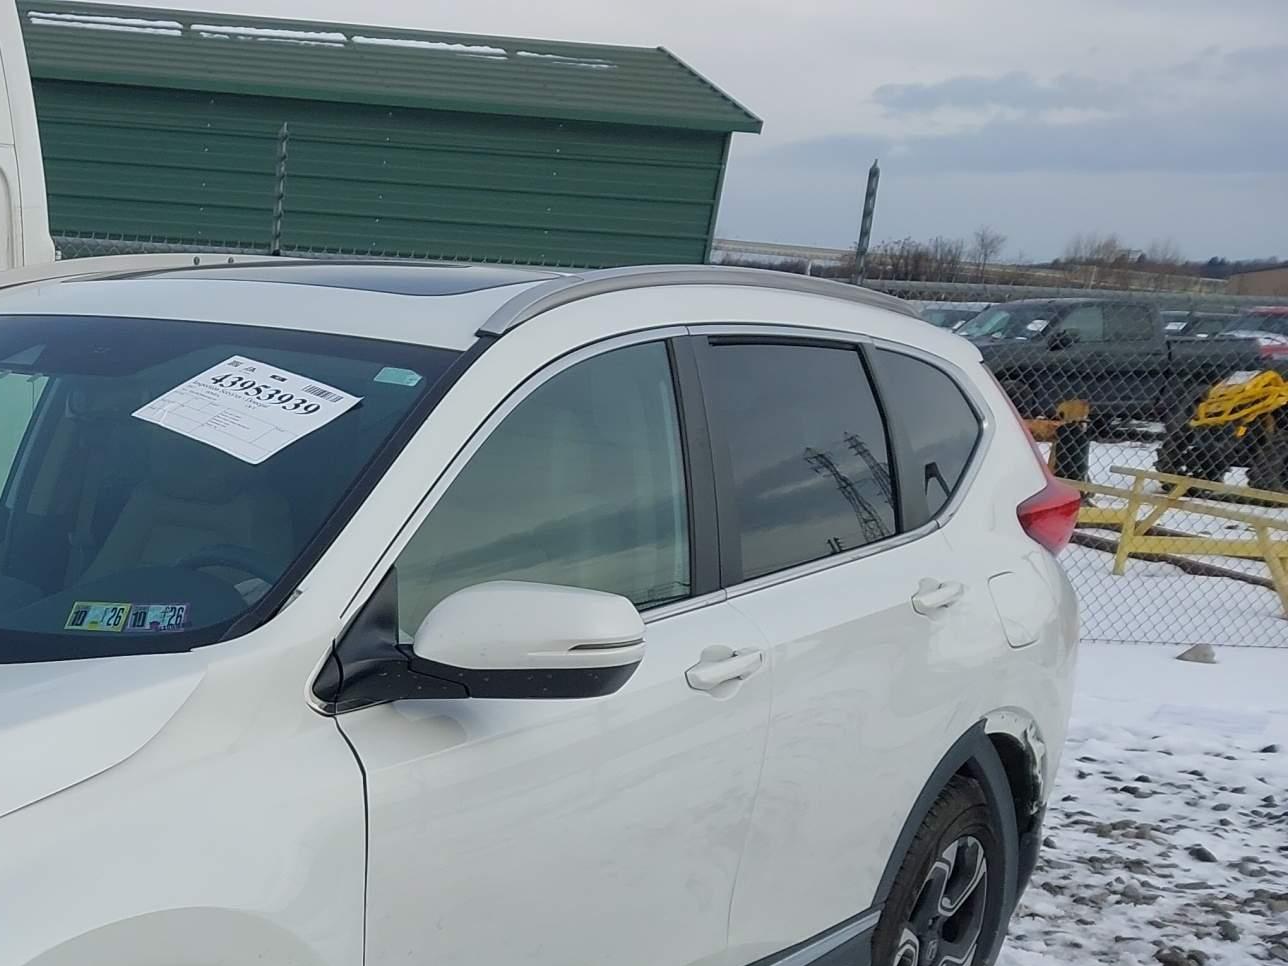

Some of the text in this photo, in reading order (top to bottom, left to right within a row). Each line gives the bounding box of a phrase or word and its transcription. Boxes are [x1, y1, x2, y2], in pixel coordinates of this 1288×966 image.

[211, 373, 321, 415] 43953939
[106, 607, 124, 627] 26
[167, 606, 184, 627] 26
